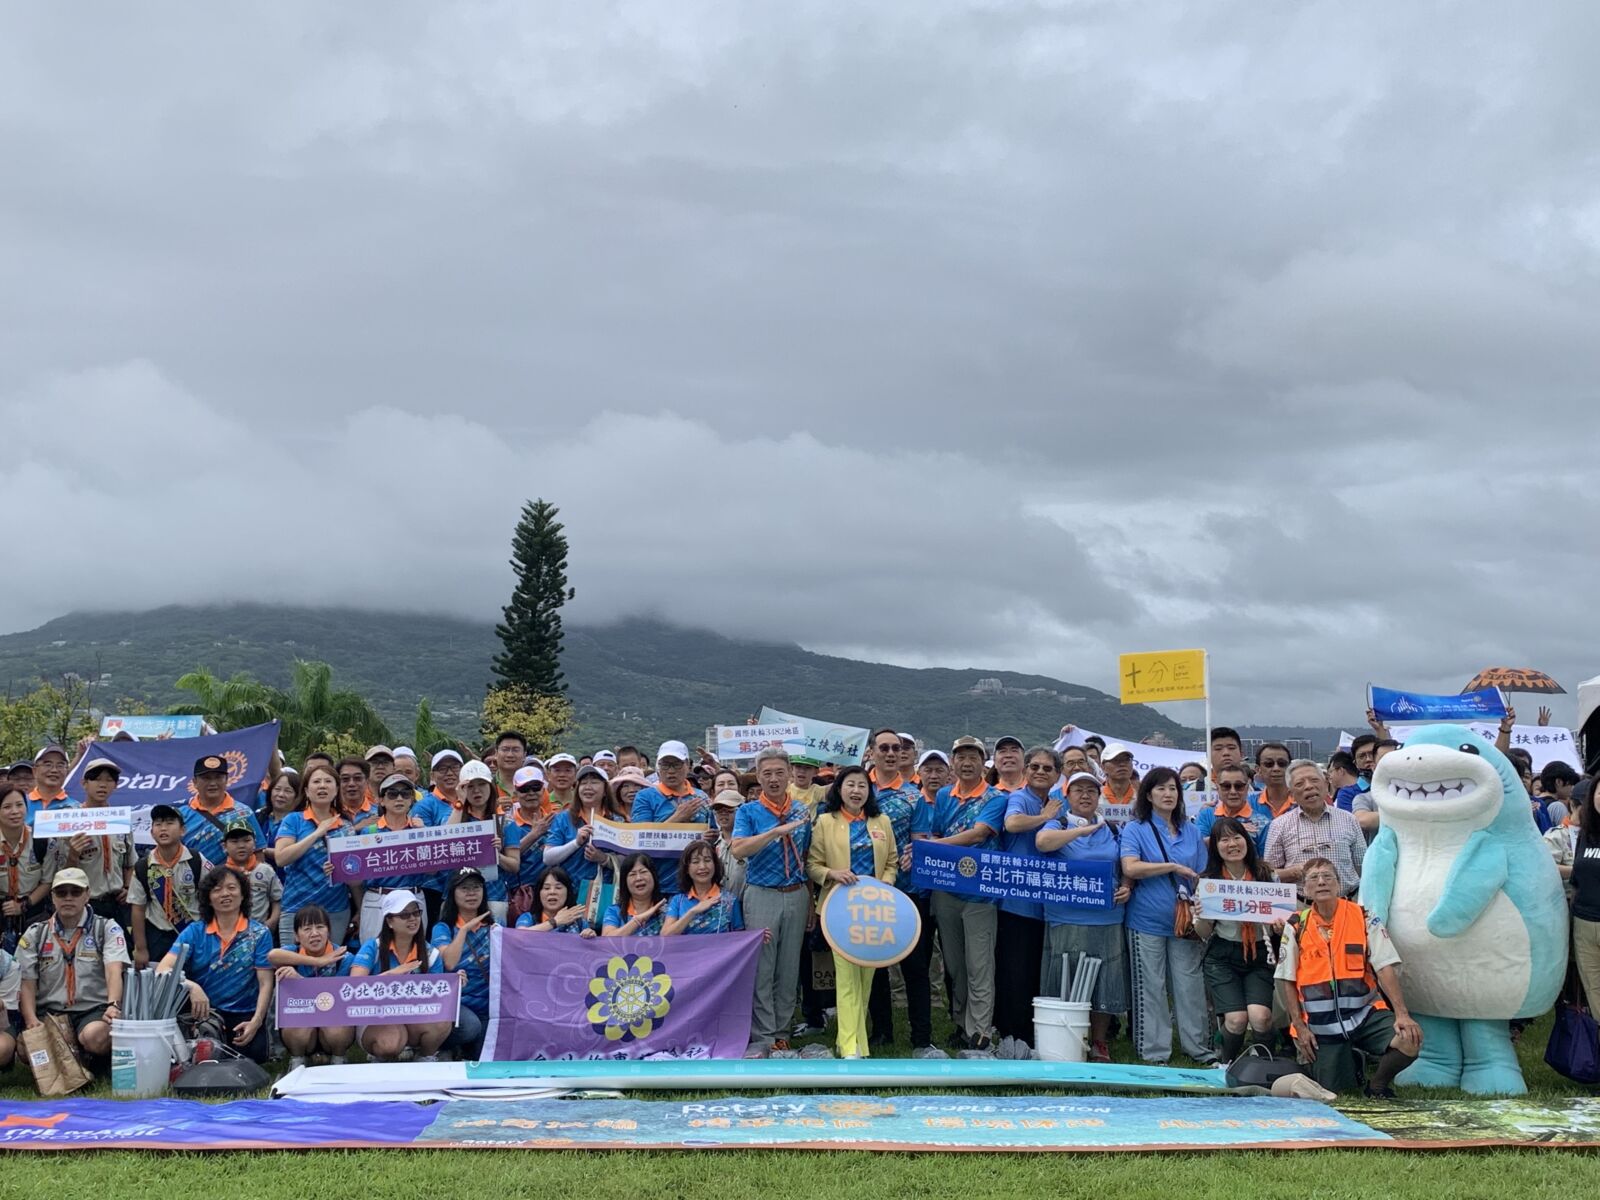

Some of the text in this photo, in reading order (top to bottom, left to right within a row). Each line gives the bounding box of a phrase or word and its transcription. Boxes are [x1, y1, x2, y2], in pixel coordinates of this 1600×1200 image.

[1125, 660, 1190, 689] 十分區
[117, 773, 188, 792] otary
[408, 824, 483, 840] 國際扶輪3482地區
[638, 831, 702, 841] 國際扶輪3482地區
[365, 840, 483, 867] 台北木蘭扶輪社
[373, 865, 399, 873] ROTARY
[429, 858, 450, 867] TAIPEI
[924, 856, 957, 870] Rotary
[980, 853, 1068, 873] 國際扶輪3482地區
[916, 866, 957, 879] Club of Taipei
[980, 866, 1106, 894] 台北市福氣扶輪社
[933, 877, 956, 887] Fortune
[847, 886, 895, 904] FOR
[979, 883, 1107, 906] Rotary Club of Taipei Fortune
[847, 904, 897, 923] THE
[1222, 898, 1273, 915] 第1分區
[848, 925, 896, 945] SEA
[341, 982, 450, 999] 台北怡東扶輪社
[682, 1103, 808, 1114] Rotary
[911, 1105, 997, 1113] PEOPLE
[1024, 1105, 1111, 1114] ACTION
[4, 1127, 166, 1137] THE MAGIC
